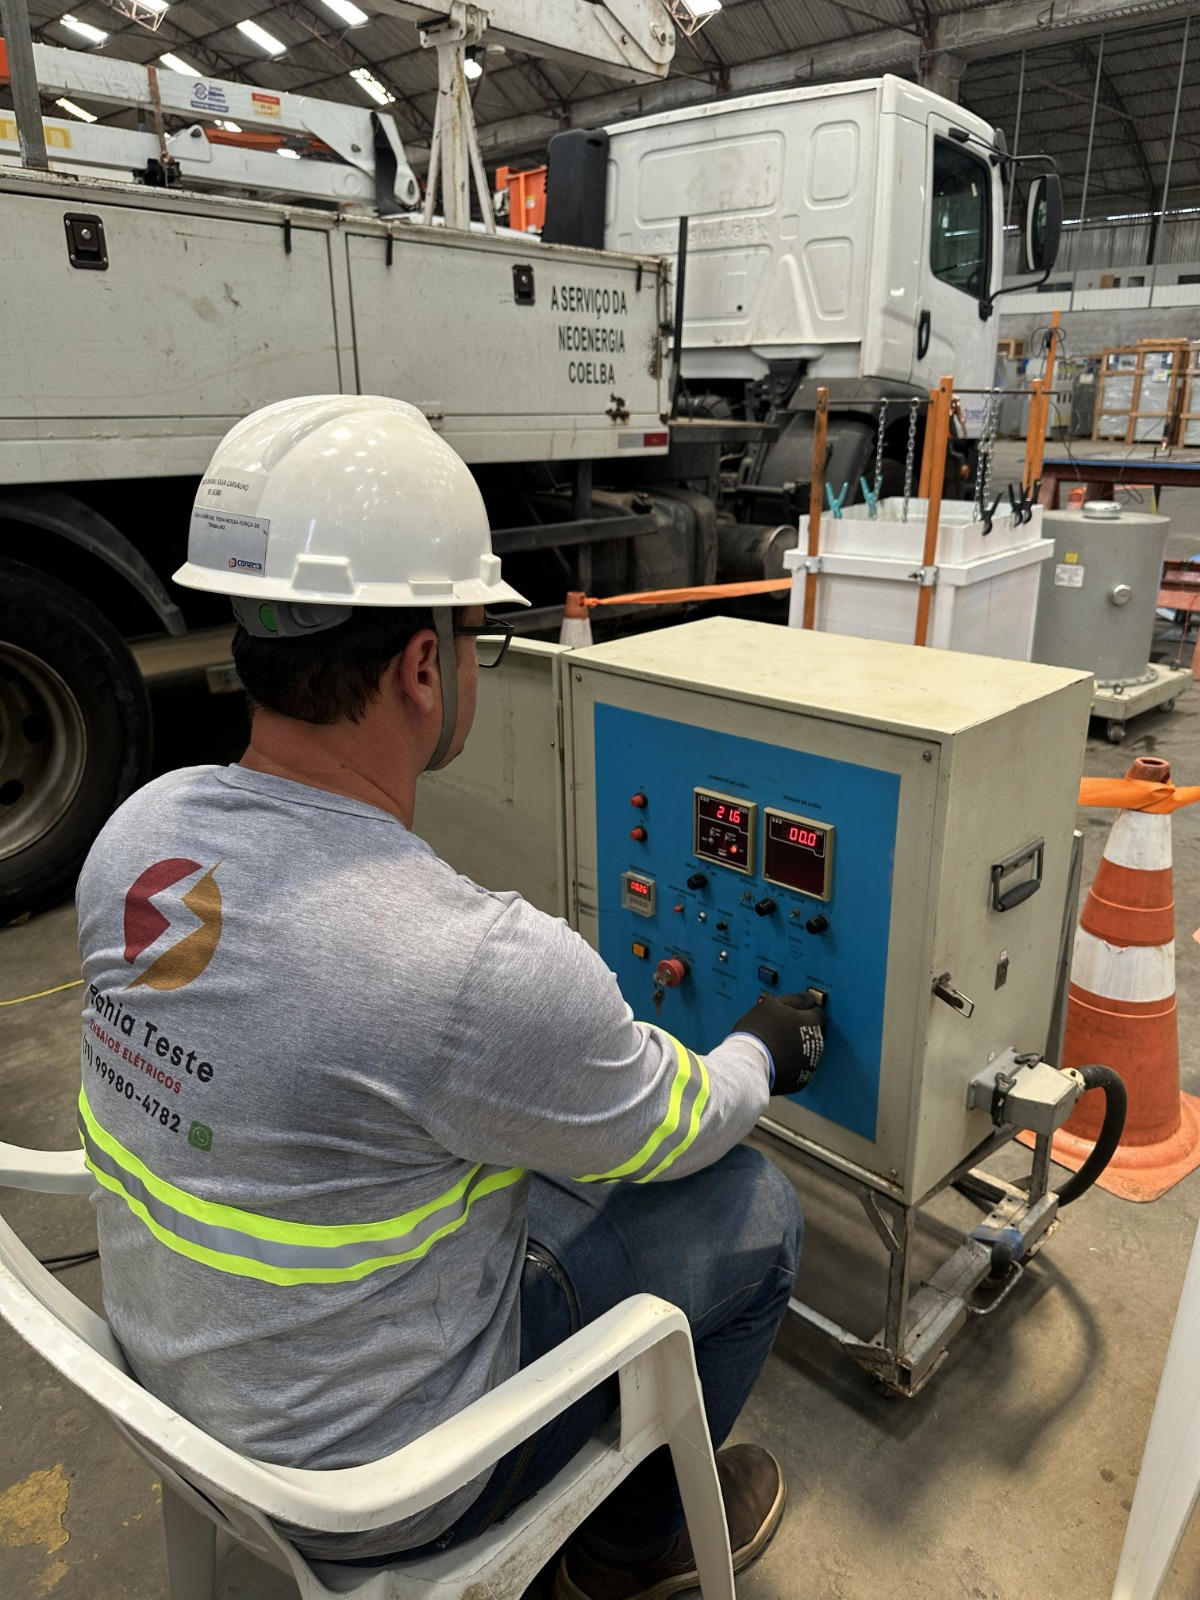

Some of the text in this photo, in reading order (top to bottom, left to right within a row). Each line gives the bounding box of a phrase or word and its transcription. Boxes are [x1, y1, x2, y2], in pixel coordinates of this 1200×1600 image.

[639, 219, 770, 250] VOLSWAGEN
[551, 285, 628, 320] A SERVIÇO DA
[558, 326, 626, 354] NEOENERGIA
[568, 361, 616, 385] COELBA
[143, 1021, 214, 1083] Teste
[122, 1047, 182, 1095] ELÉTRICOS
[95, 1056, 181, 1133] 99980-4782
